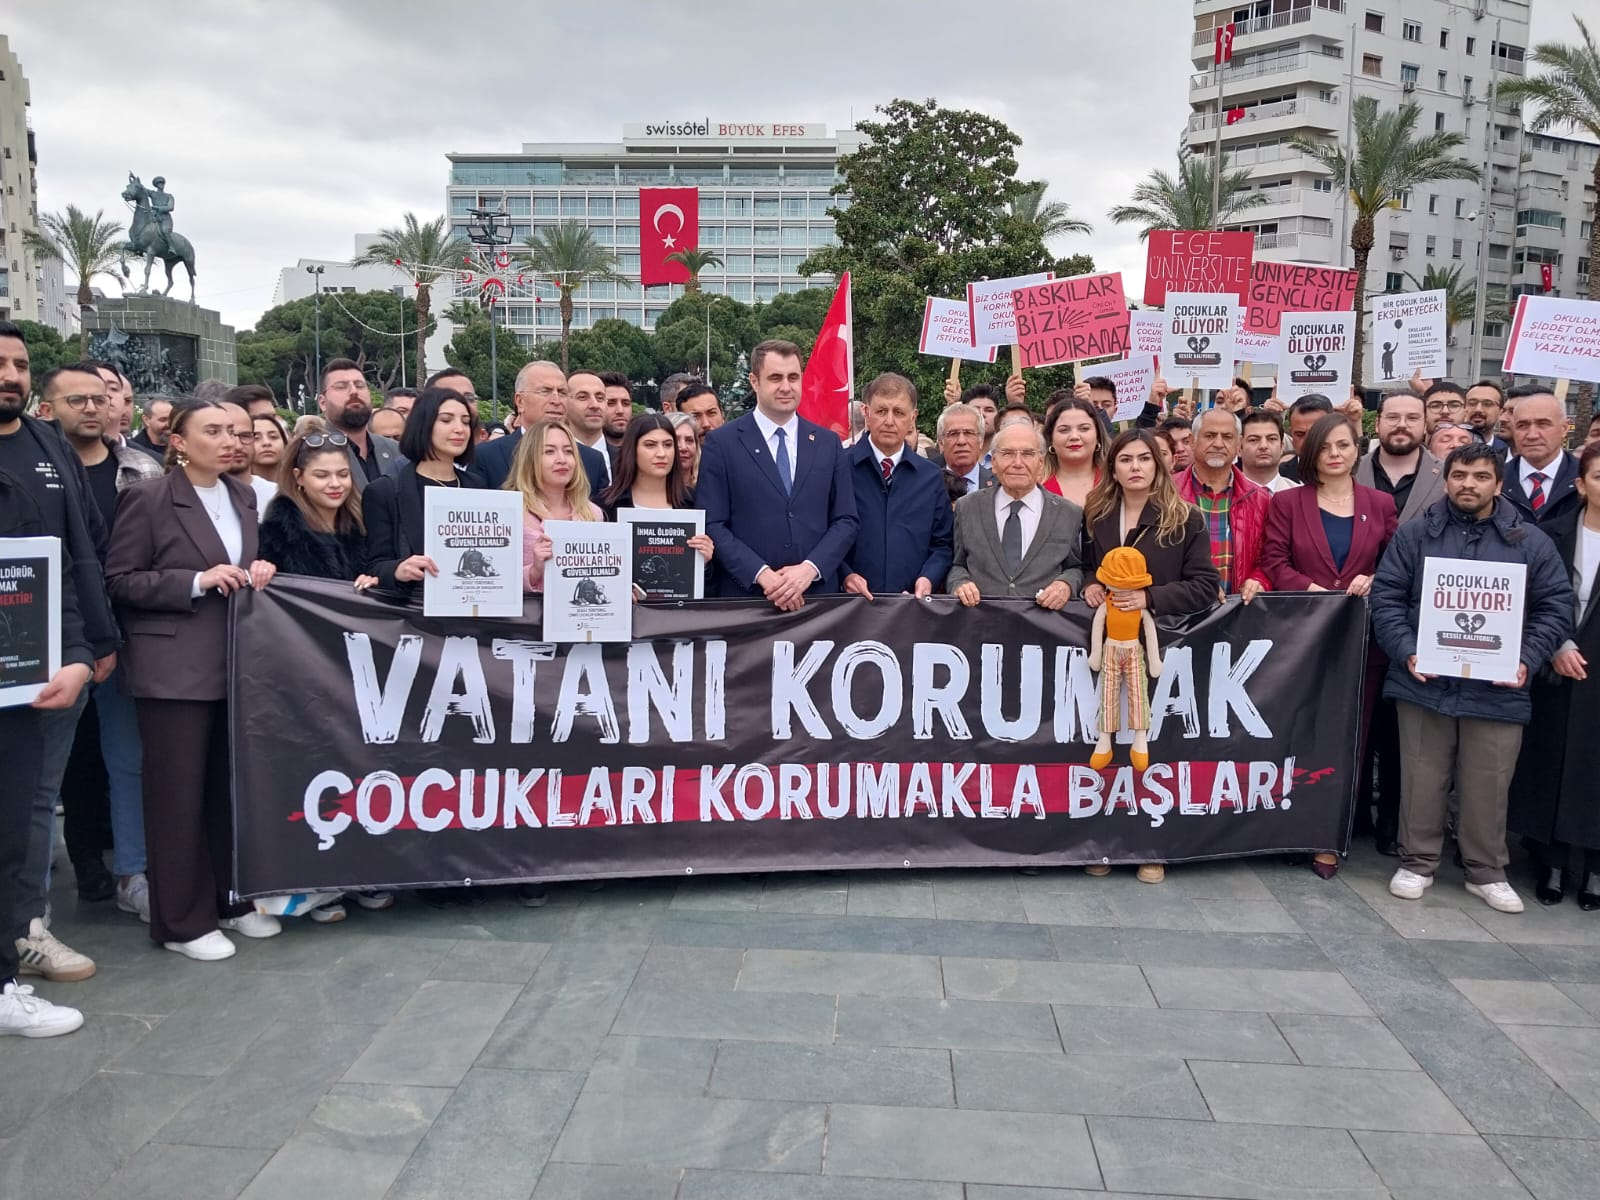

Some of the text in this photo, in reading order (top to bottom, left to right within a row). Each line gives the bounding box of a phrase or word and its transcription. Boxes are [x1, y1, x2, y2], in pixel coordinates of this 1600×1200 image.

[646, 117, 709, 136] swissôtel
[718, 123, 765, 136] BÜYÜK
[1171, 232, 1225, 257] EGE
[1012, 276, 1118, 311] BASKILAR
[983, 300, 1014, 312] KORKM
[1383, 295, 1438, 308] BİR ÇOCUK DAHA
[948, 309, 969, 319] OKUL
[1174, 305, 1228, 318] ÇOCUKLAR
[1377, 301, 1443, 321] EKSİLMEYECEK!
[987, 318, 1015, 331] İSTİYO
[1172, 317, 1229, 335] ÖLÜYOR!
[1553, 314, 1598, 325] OKULDA
[942, 325, 970, 336] GELEC
[1290, 323, 1345, 336] ÇOCUKLAR
[1521, 331, 1567, 341] GELECEK
[1575, 326, 1600, 336] OLM
[935, 333, 970, 345] İSTİYOR
[1019, 324, 1132, 366] YILDIRAMAZ
[1288, 335, 1346, 354] ÖLÜYOR!
[1138, 344, 1162, 353] KADA
[448, 510, 499, 524] OKULLAR
[637, 527, 656, 536] İHMAL
[648, 537, 674, 545] SUSMAK
[565, 542, 611, 555] OKULLAR
[1437, 573, 1510, 591] ÇOCUKLAR
[1433, 587, 1512, 612] ÖLÜYOR!
[343, 632, 728, 745] VATANI
[303, 755, 1297, 851] ÇOCUKLARI KORUMAKLA BAŞLAR!
